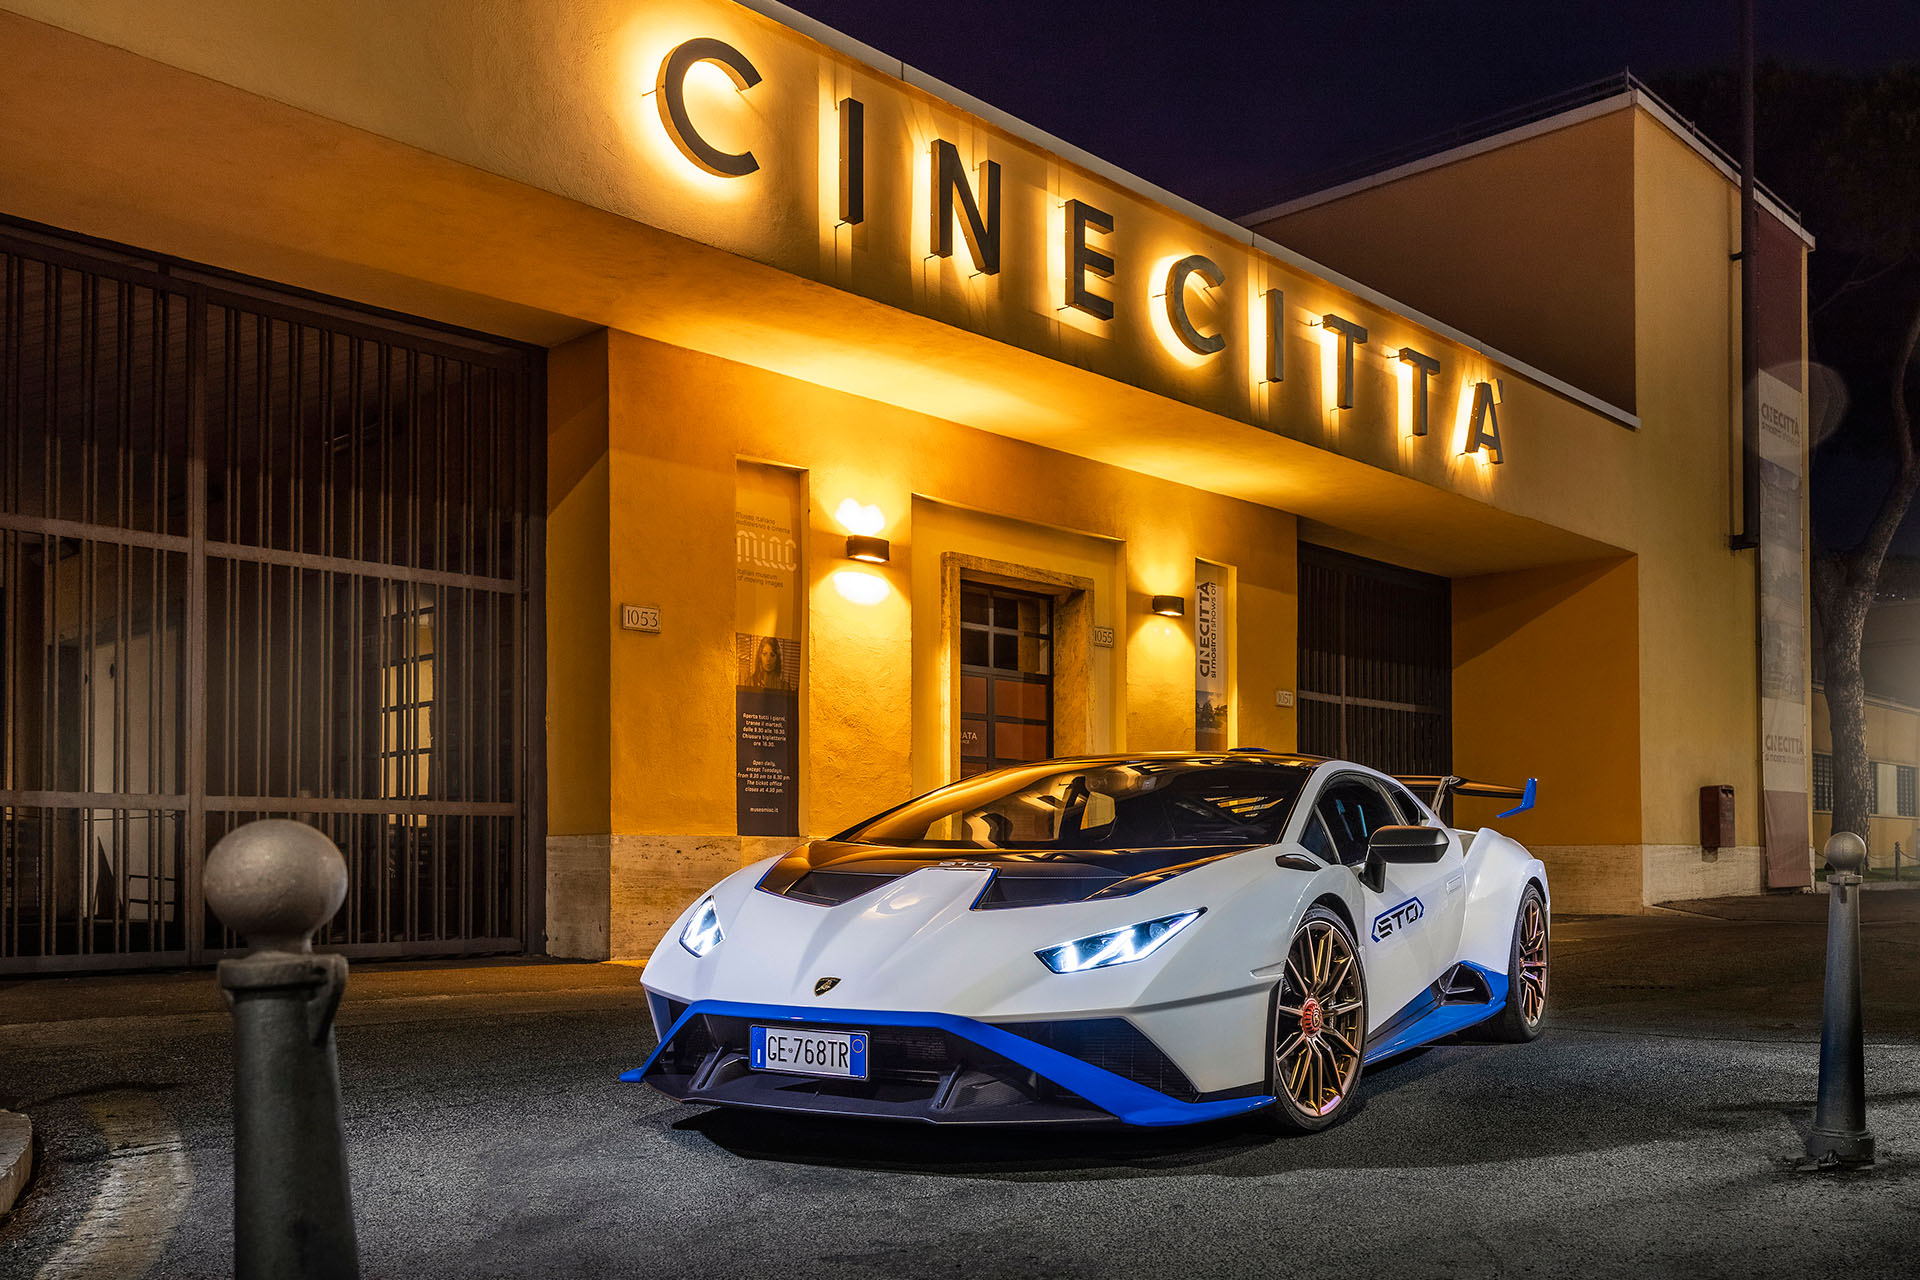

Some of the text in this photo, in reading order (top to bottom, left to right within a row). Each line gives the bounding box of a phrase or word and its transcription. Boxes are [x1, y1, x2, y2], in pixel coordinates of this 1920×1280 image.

[627, 609, 658, 628] 1053
[1095, 630, 1113, 644] 1055
[1196, 581, 1210, 678] CINECITTÀ
[1211, 671, 1217, 679] si
[1377, 902, 1419, 939] STO
